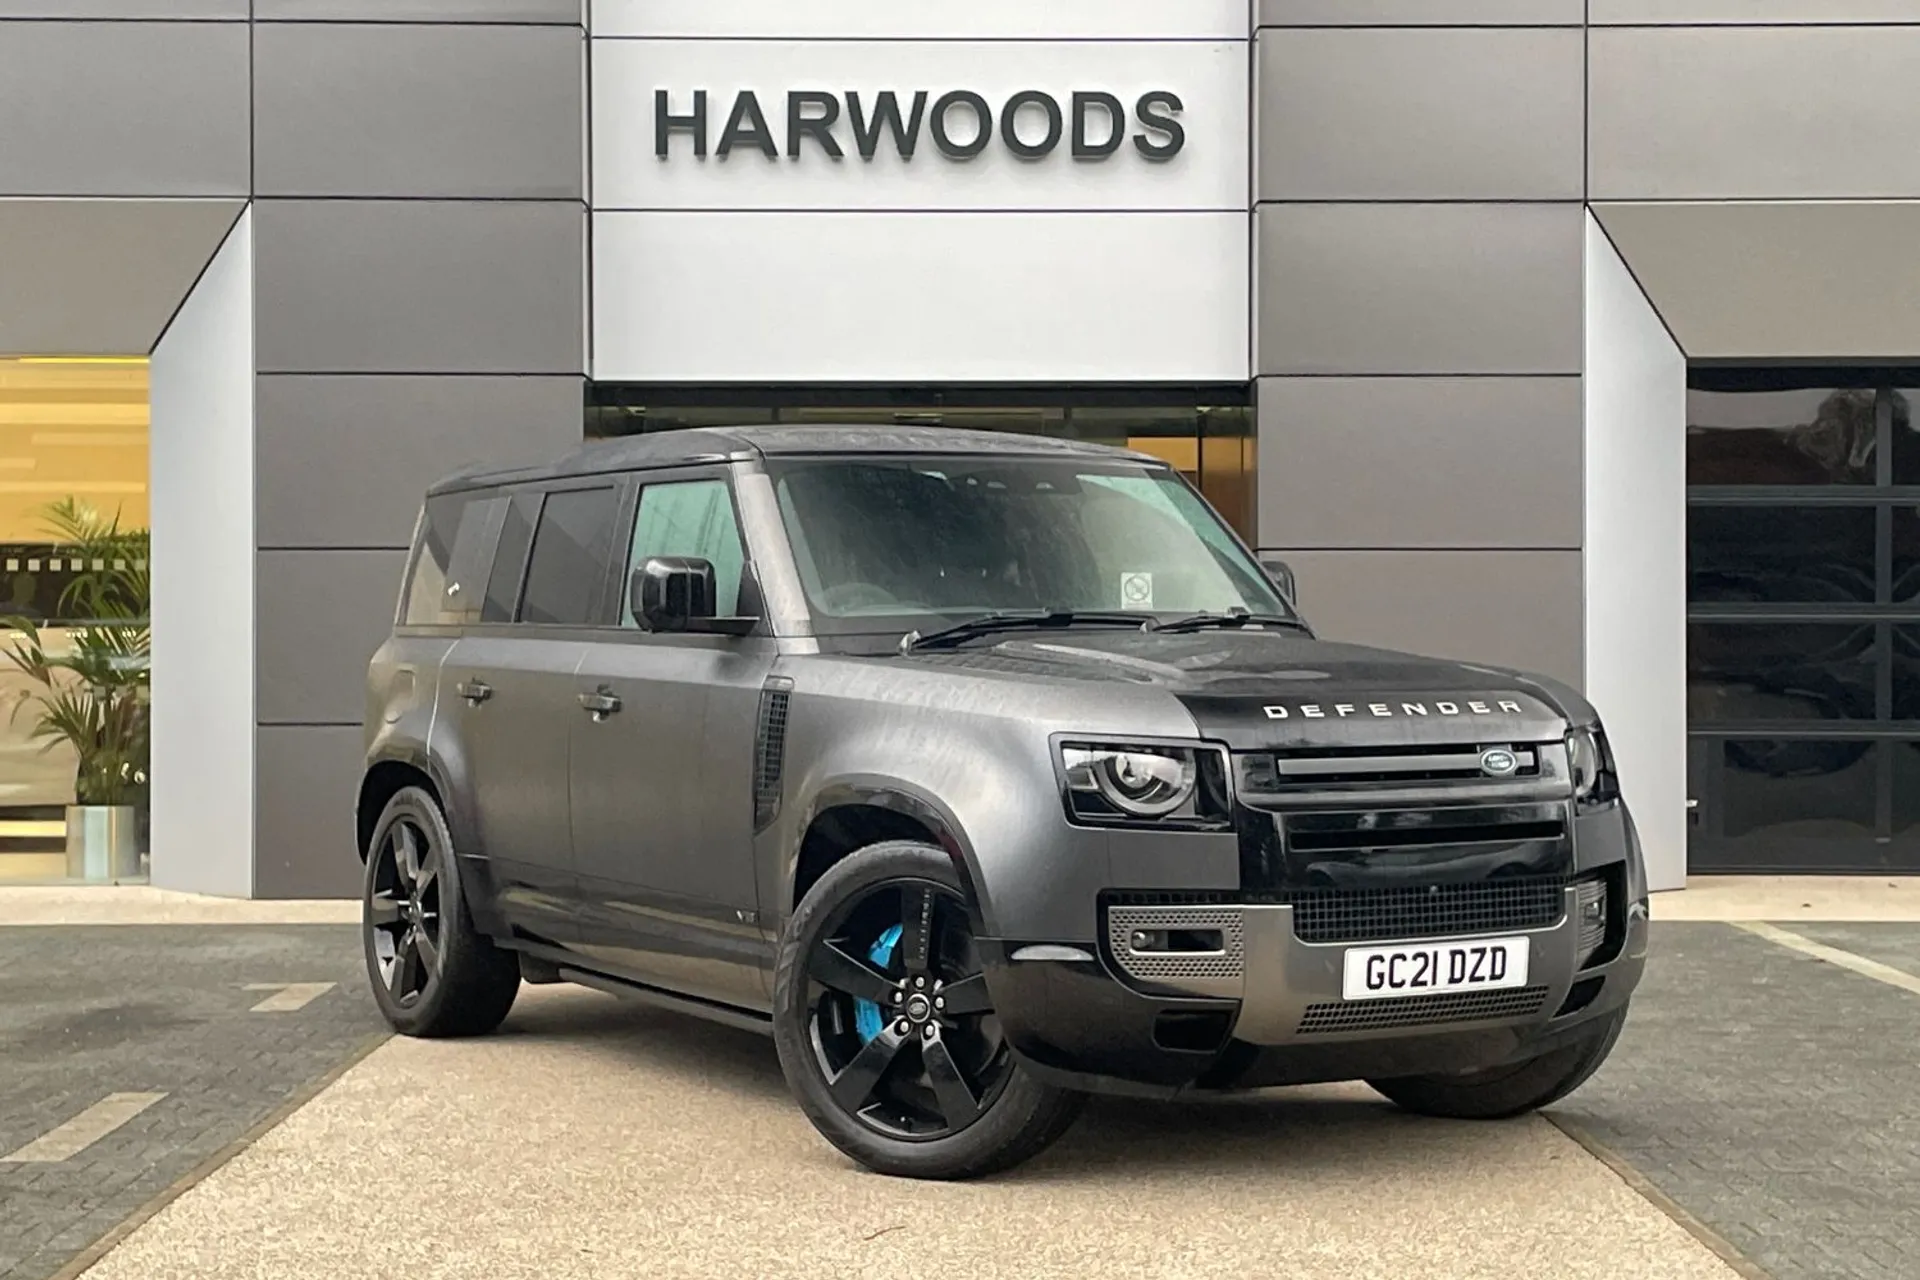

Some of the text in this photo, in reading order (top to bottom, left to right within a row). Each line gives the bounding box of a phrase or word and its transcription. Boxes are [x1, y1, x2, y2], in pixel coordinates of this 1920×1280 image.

[655, 90, 1186, 160] HARWOODS
[1263, 700, 1522, 719] DEFENDER
[1366, 946, 1507, 990] GC21 DZD
